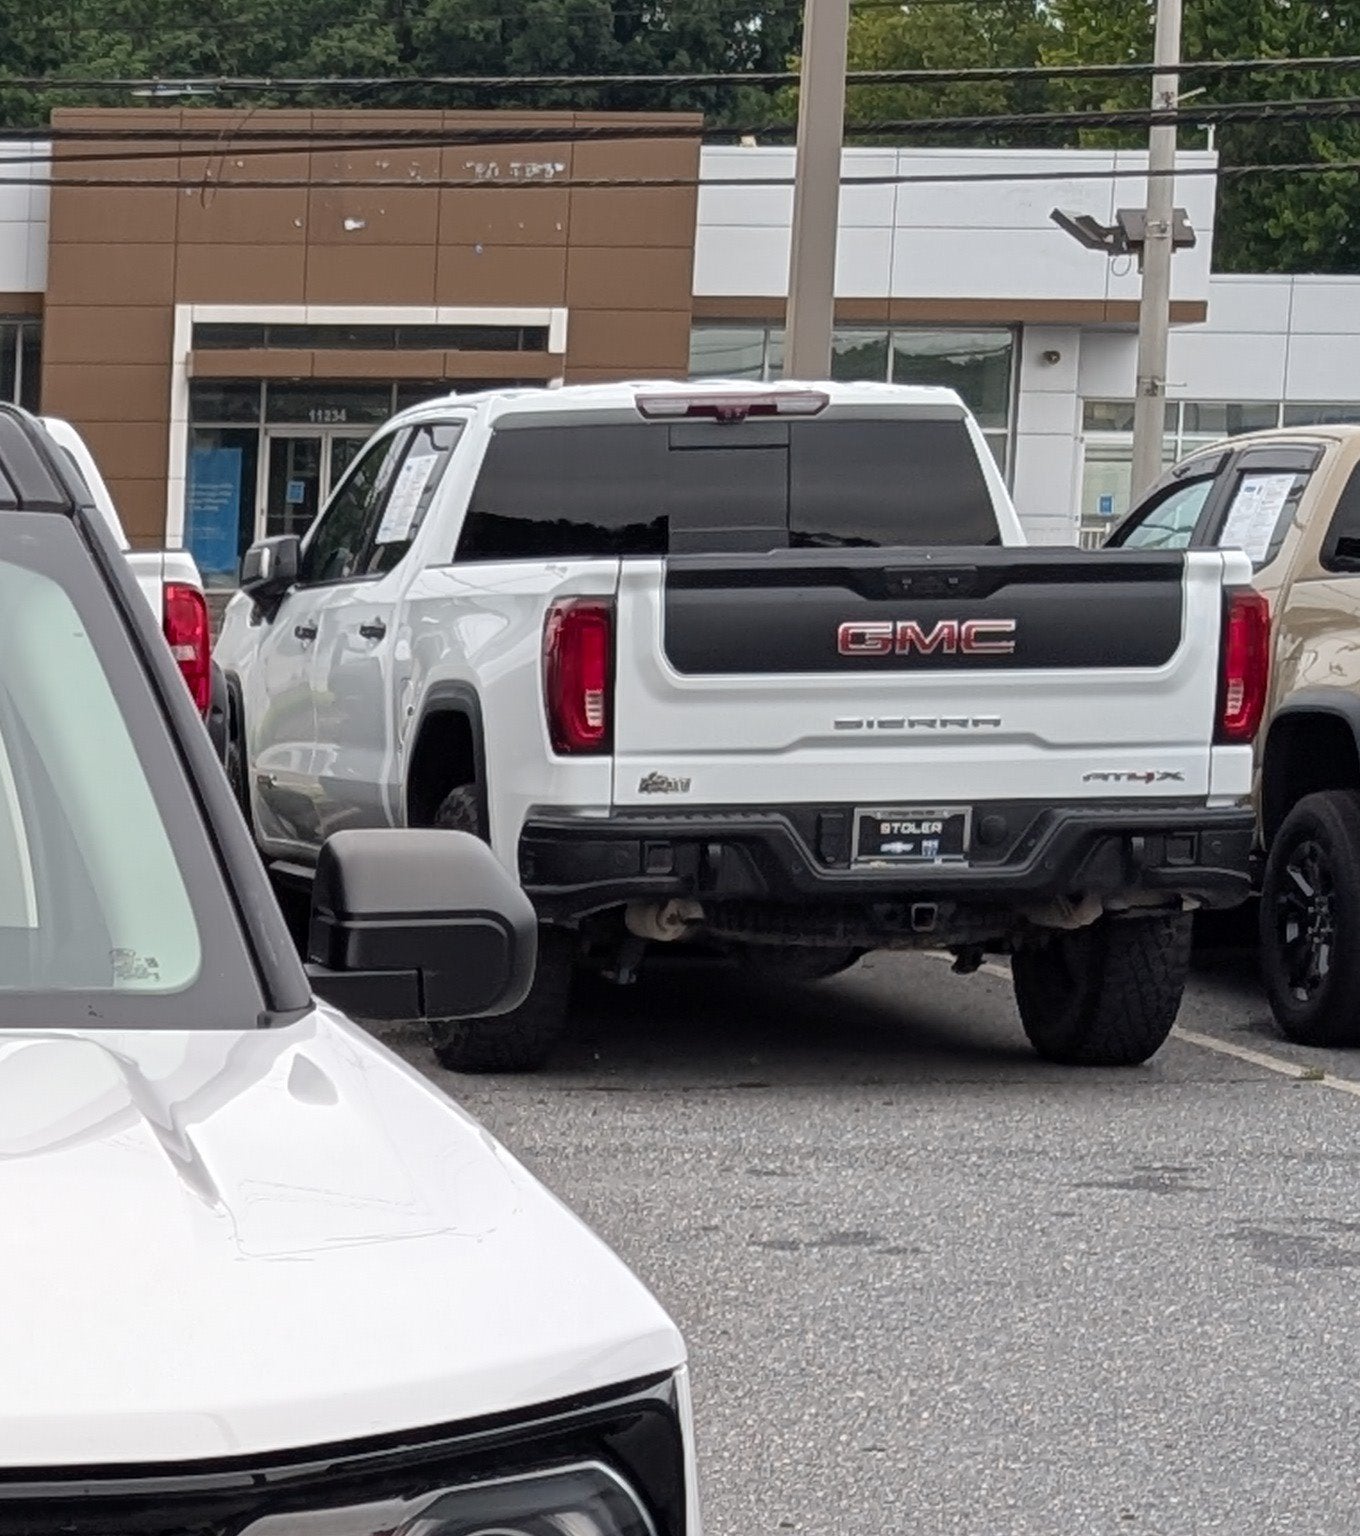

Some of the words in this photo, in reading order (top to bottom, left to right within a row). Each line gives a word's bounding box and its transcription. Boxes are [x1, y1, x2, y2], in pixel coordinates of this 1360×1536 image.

[837, 619, 1017, 656] GMC
[834, 714, 1002, 730] SIERRA
[880, 821, 943, 835] STOLER
